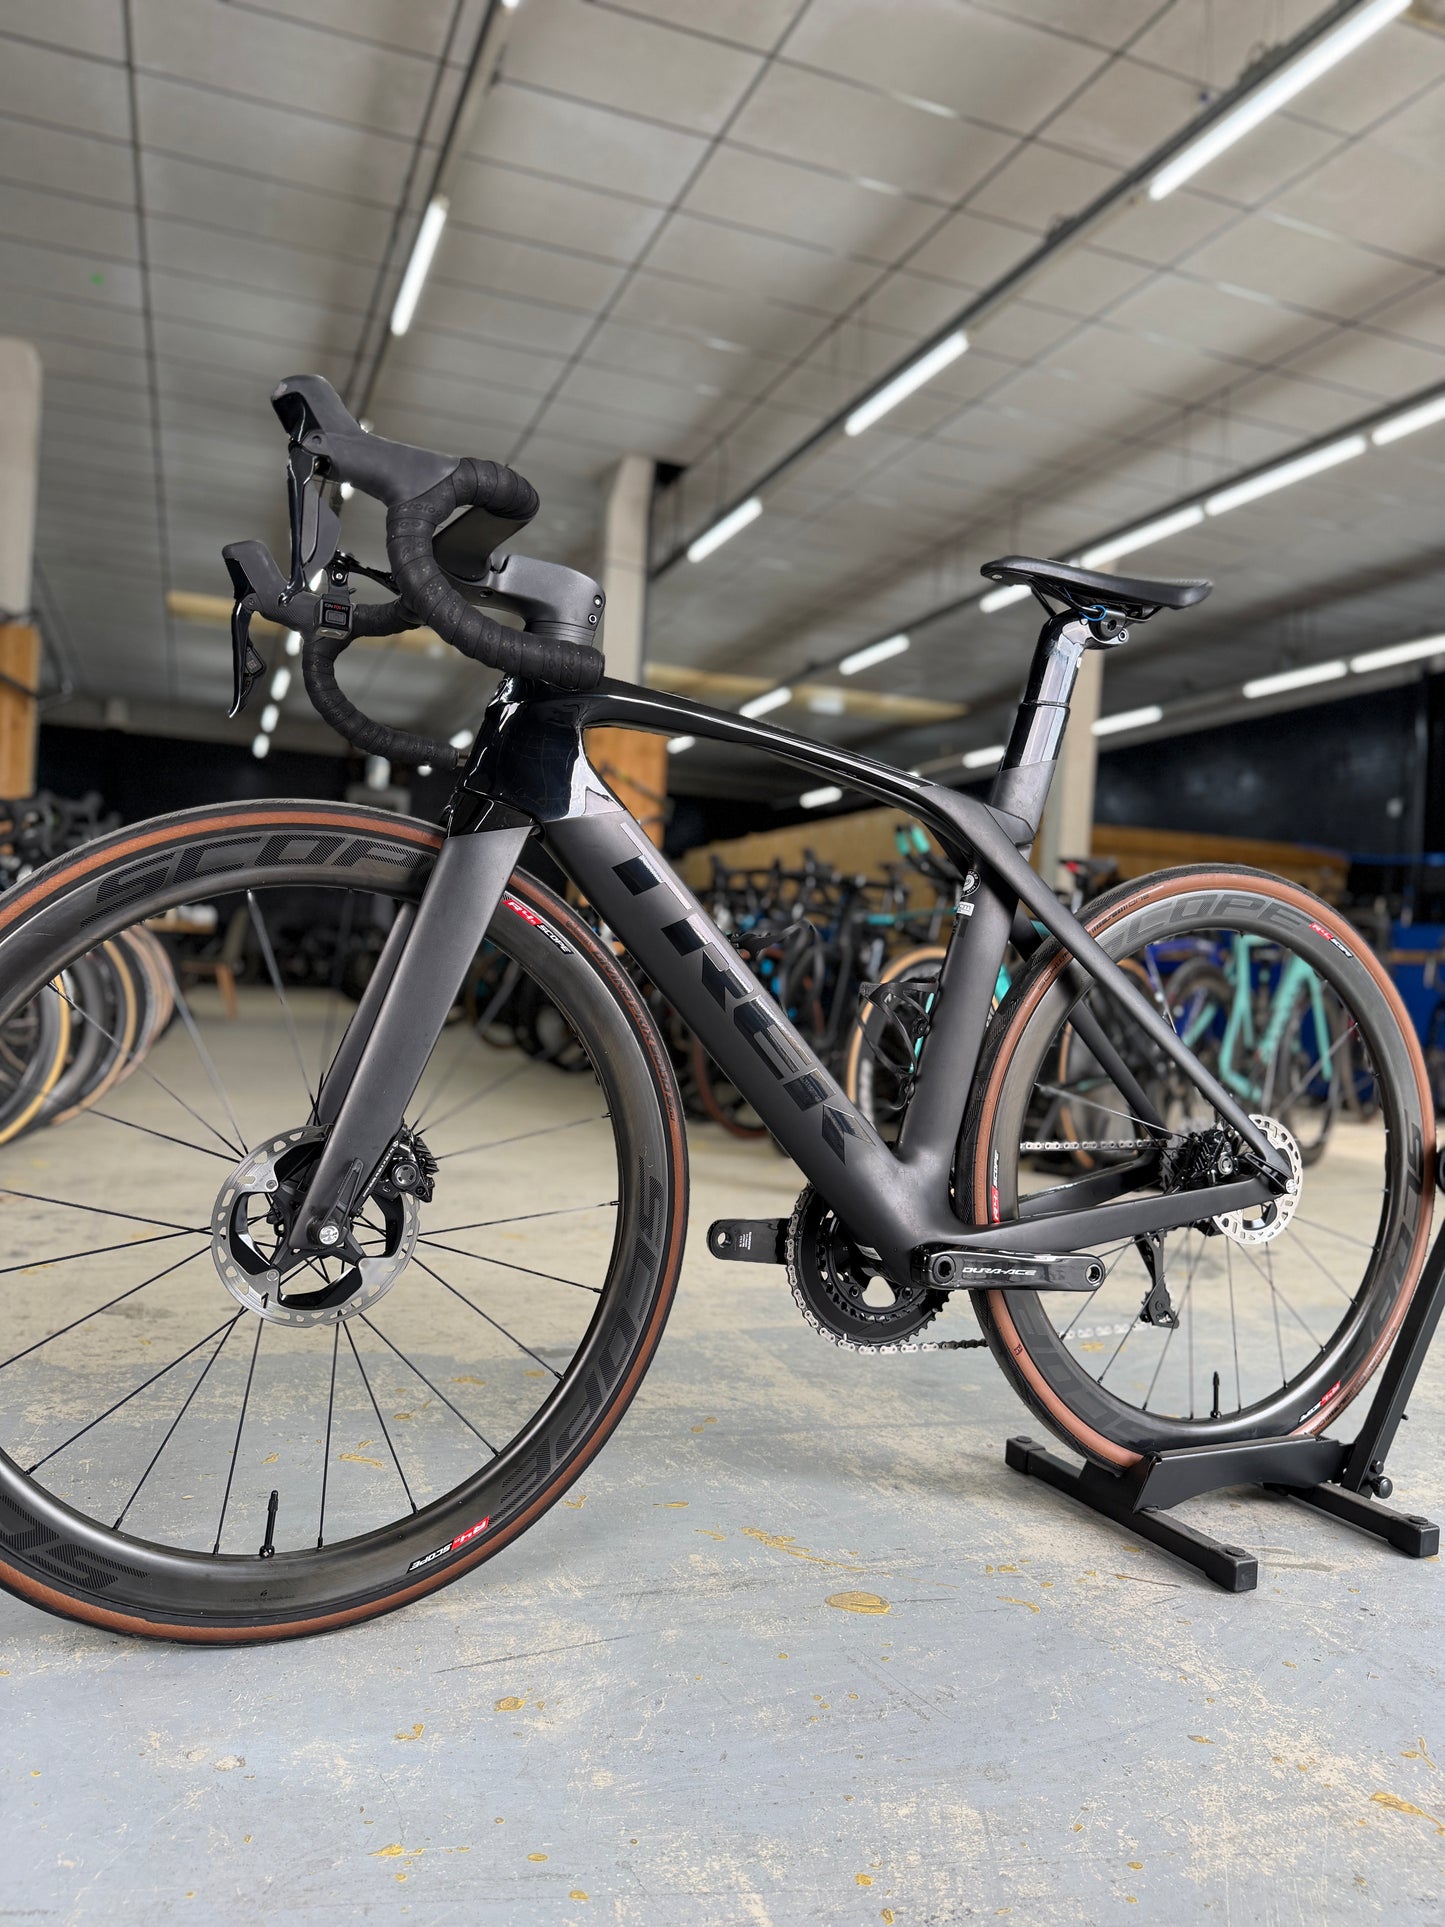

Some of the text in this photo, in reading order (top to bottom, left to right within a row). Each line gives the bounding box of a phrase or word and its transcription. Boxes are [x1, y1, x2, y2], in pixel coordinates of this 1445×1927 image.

[79, 833, 438, 928] SCOP
[536, 924, 572, 953] SCOPE
[611, 821, 877, 1165] TREK
[962, 1267, 1037, 1276] DURA-ACE
[489, 1155, 663, 1523] SCOPE
[408, 1542, 453, 1571] SCOPE
